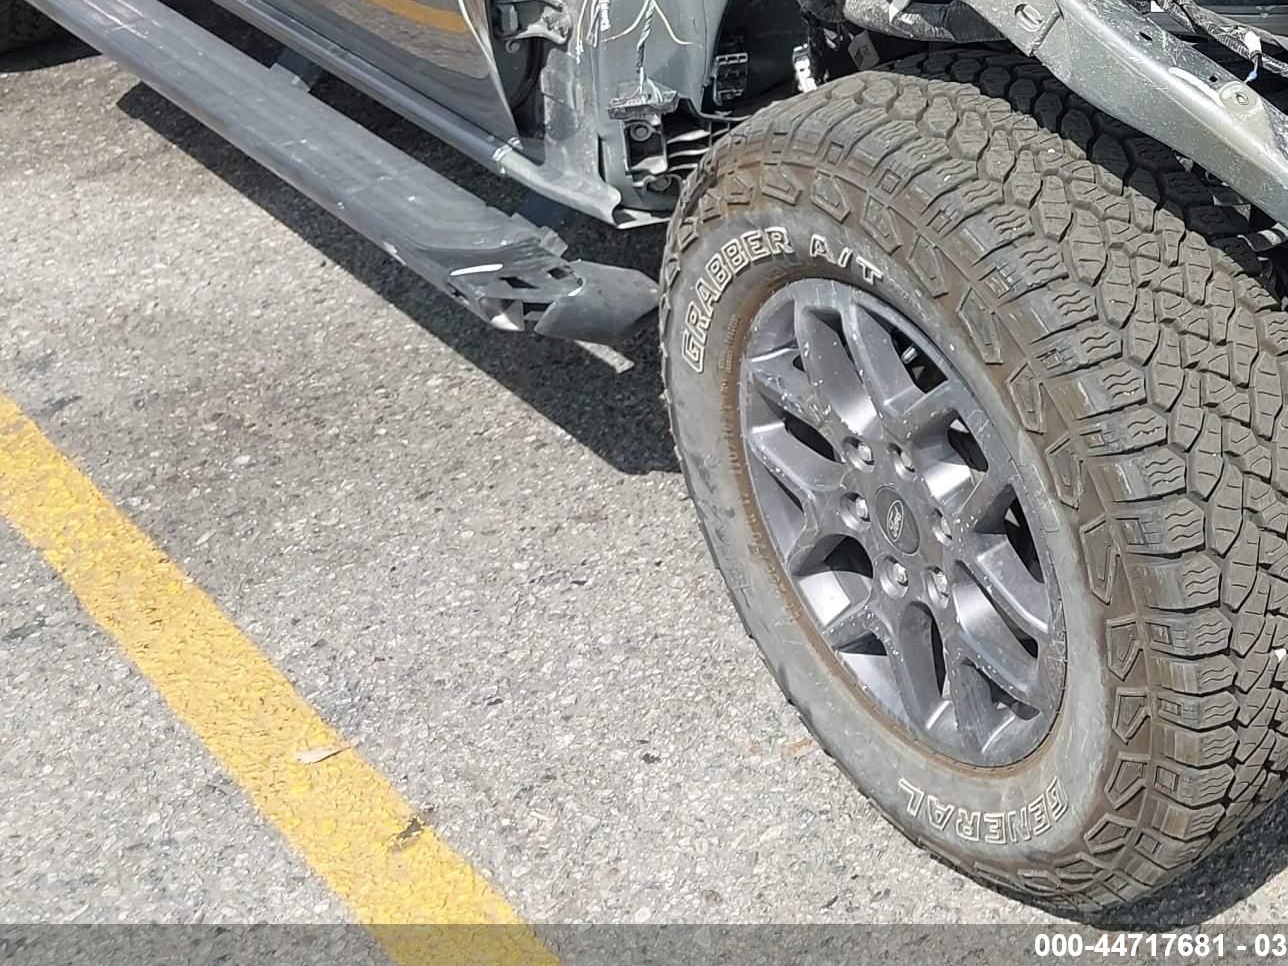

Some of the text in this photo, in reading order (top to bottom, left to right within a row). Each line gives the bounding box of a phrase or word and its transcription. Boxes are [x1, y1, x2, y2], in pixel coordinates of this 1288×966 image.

[681, 225, 794, 373] GRABBER
[809, 233, 883, 285] A/T
[898, 776, 1069, 845] GENERAL
